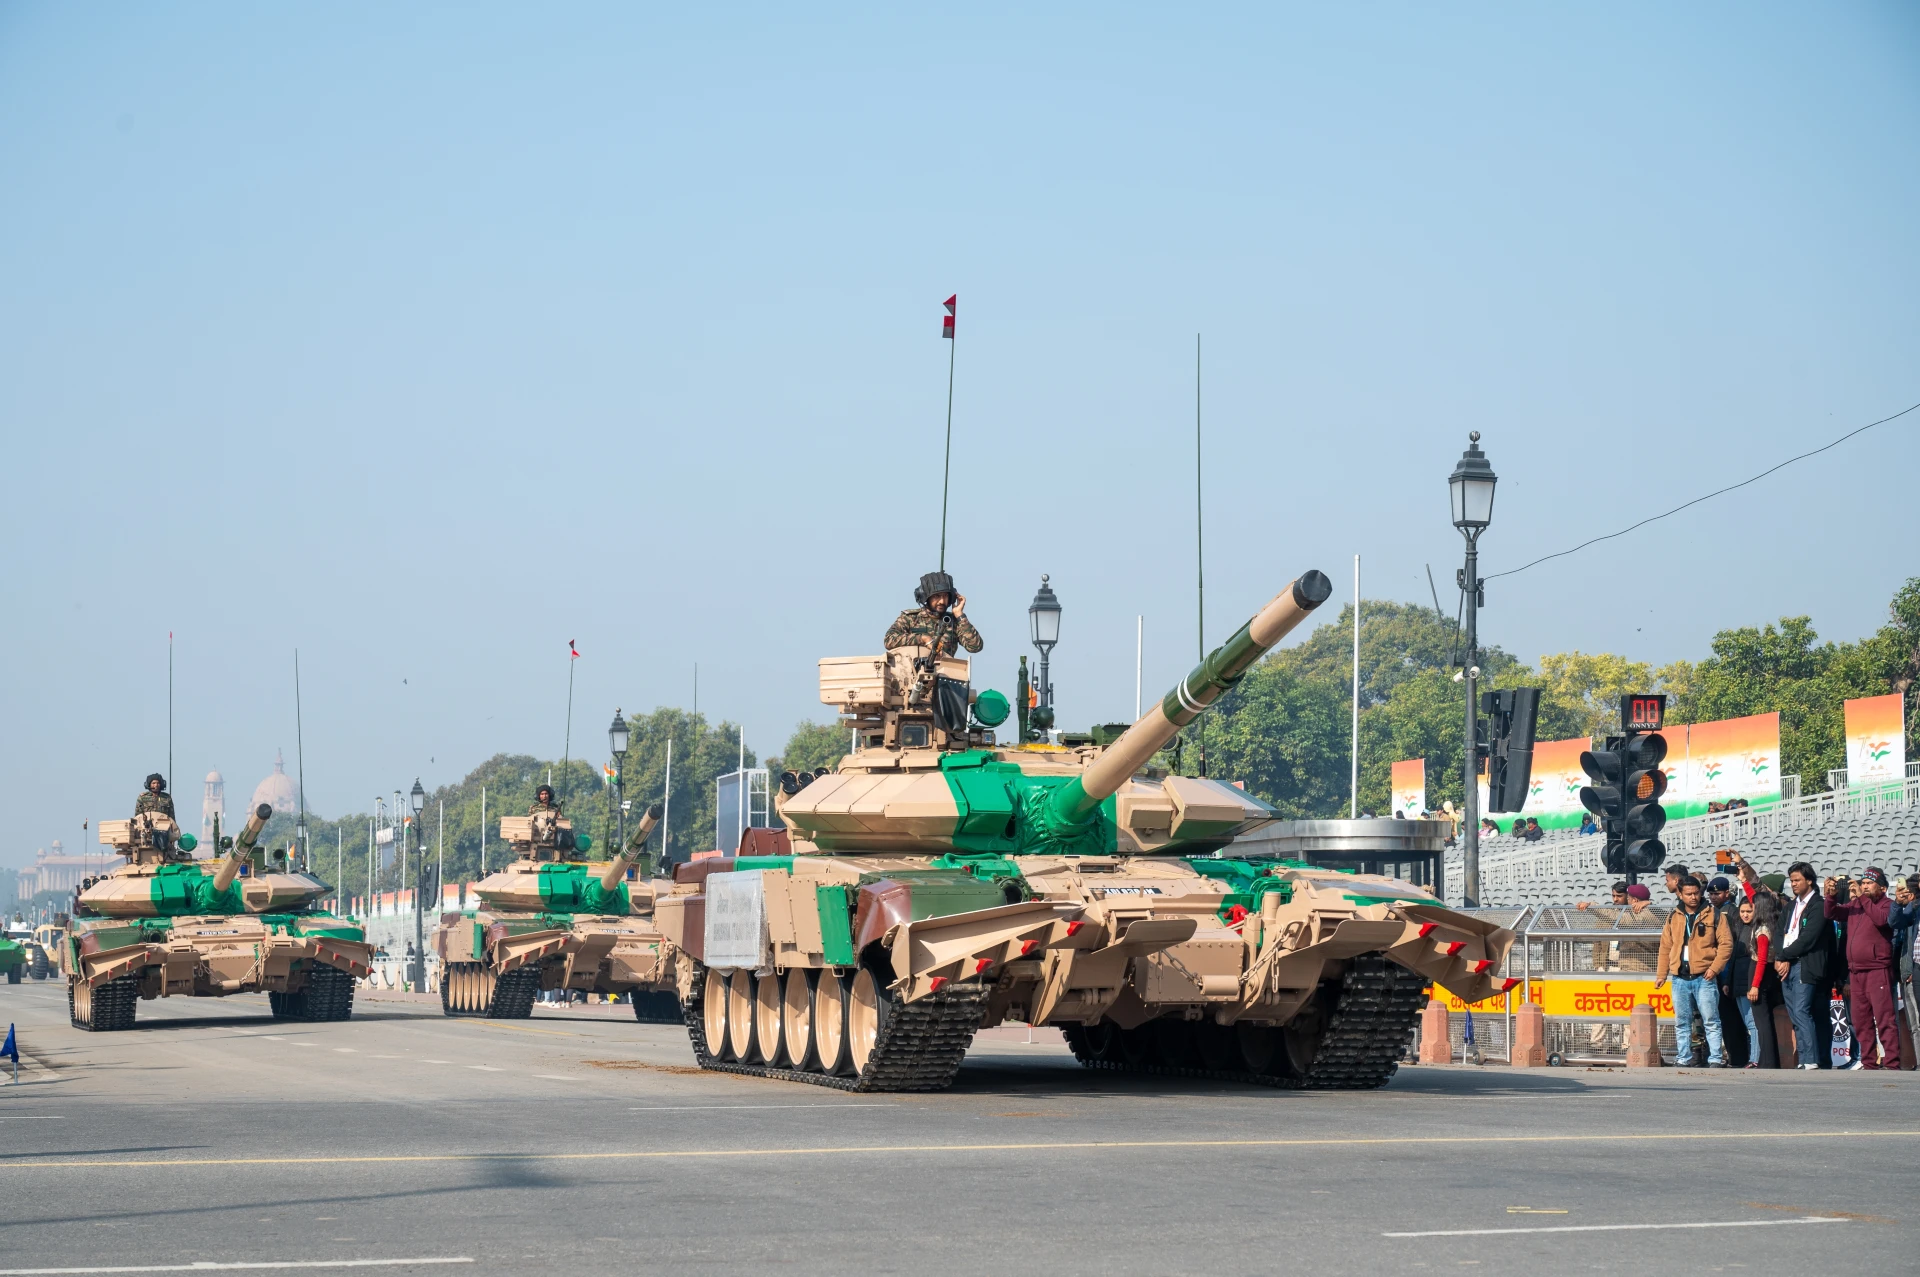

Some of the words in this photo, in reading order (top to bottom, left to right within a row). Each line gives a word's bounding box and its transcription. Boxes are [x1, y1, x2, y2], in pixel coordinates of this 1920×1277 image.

[1633, 699, 1659, 723] 00
[1574, 983, 1636, 1013] कर्त्तव्य
[1647, 993, 1676, 1015] पथ
